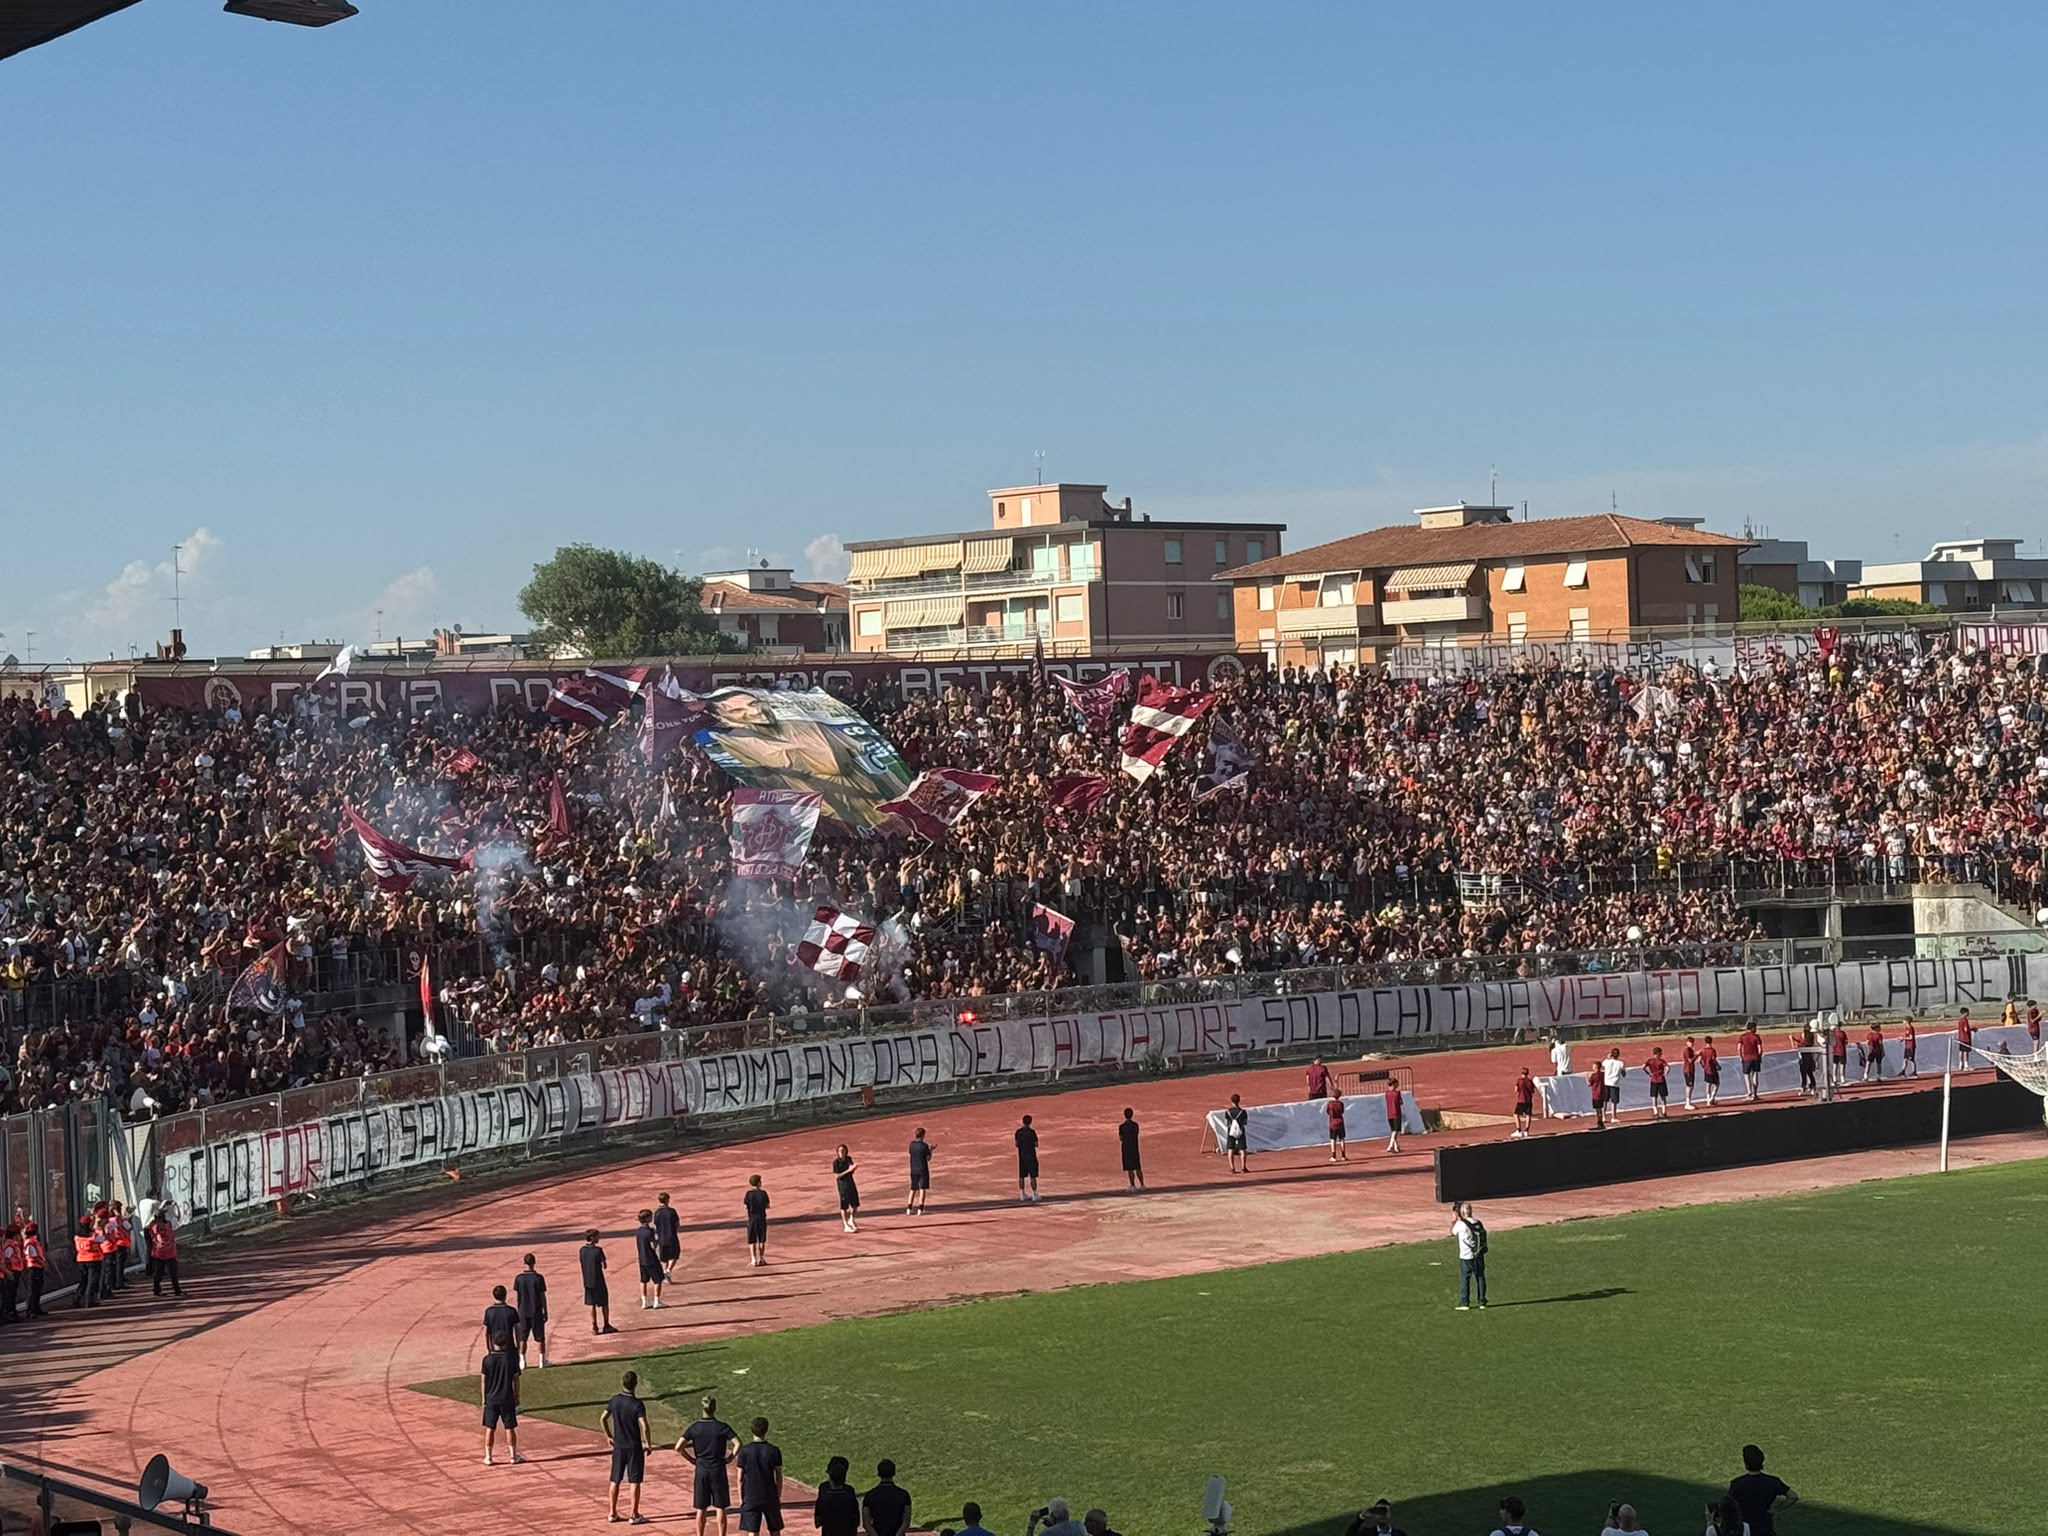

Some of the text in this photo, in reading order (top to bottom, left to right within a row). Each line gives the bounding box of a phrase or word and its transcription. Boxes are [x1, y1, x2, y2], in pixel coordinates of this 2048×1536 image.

[190, 1138, 251, 1218] CIAO
[260, 1123, 322, 1198] IGOR
[328, 1108, 391, 1180] OGGI
[400, 1082, 567, 1161] SALUTIAMO
[700, 1049, 793, 1112] PRIMA
[804, 1033, 940, 1093] ANCORA
[951, 1026, 1016, 1077] DEL
[1265, 992, 1362, 1044] SOLO
[1374, 987, 1433, 1042] CHI
[1440, 984, 1473, 1031] TI
[1484, 980, 1533, 1030] HA
[1539, 970, 1701, 1022] VISSUTO
[1714, 968, 1747, 1014] CI
